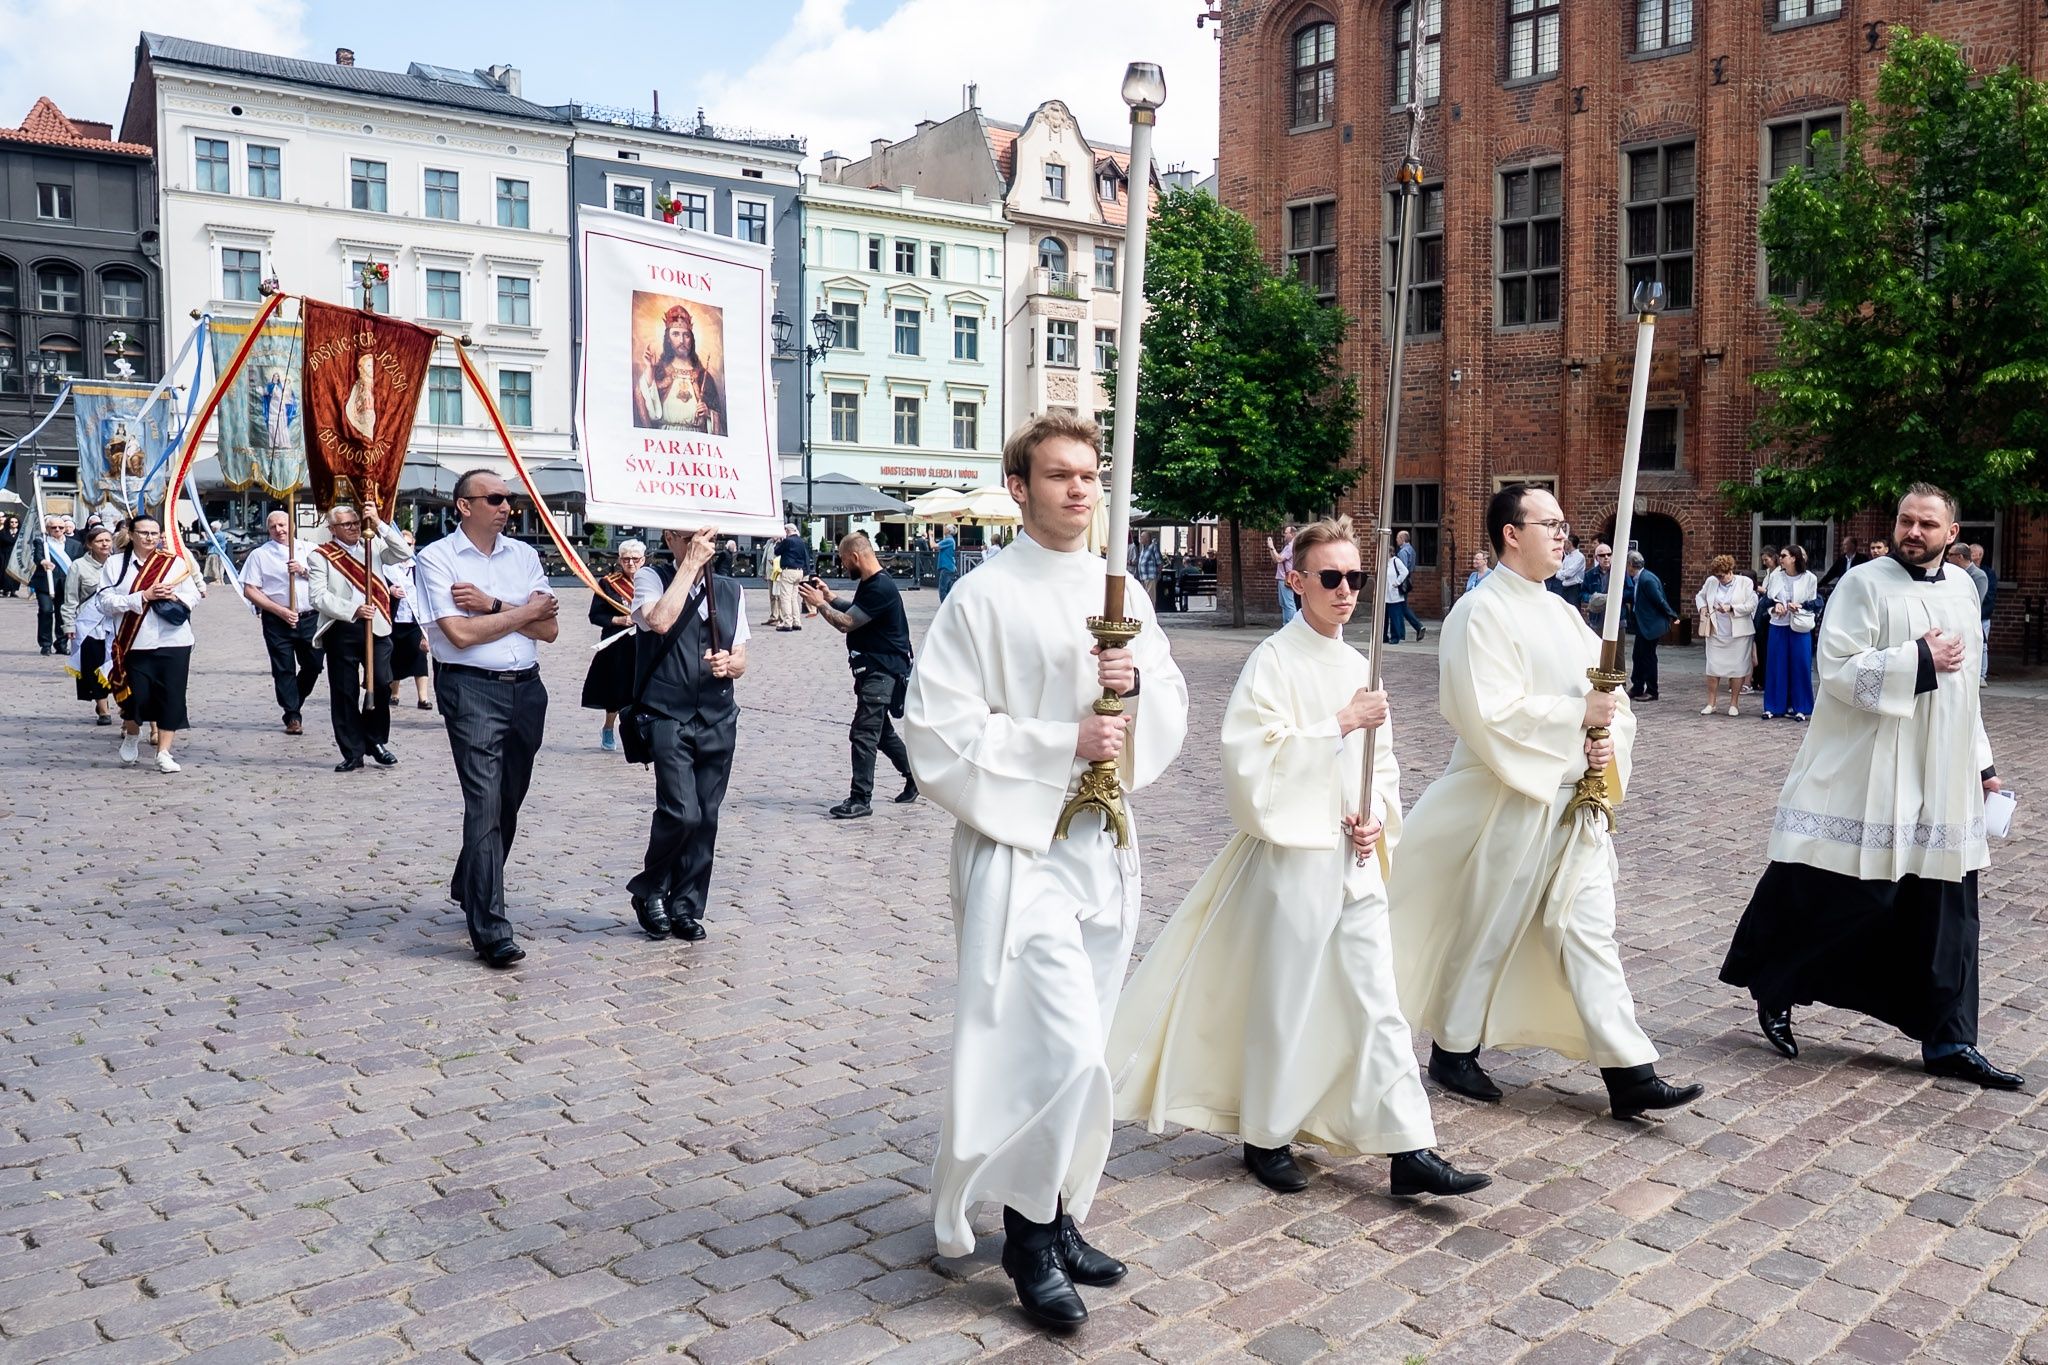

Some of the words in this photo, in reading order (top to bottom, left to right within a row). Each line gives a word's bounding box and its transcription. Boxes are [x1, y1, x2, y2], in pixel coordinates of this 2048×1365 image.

[646, 263, 712, 292] TORUŃ
[643, 438, 723, 459] PARAFIA
[625, 453, 662, 474] ŚW.
[666, 460, 740, 481] JAKUBA
[880, 466, 927, 478] MINISTERSTWO
[635, 479, 737, 500] APOSTOŁA
